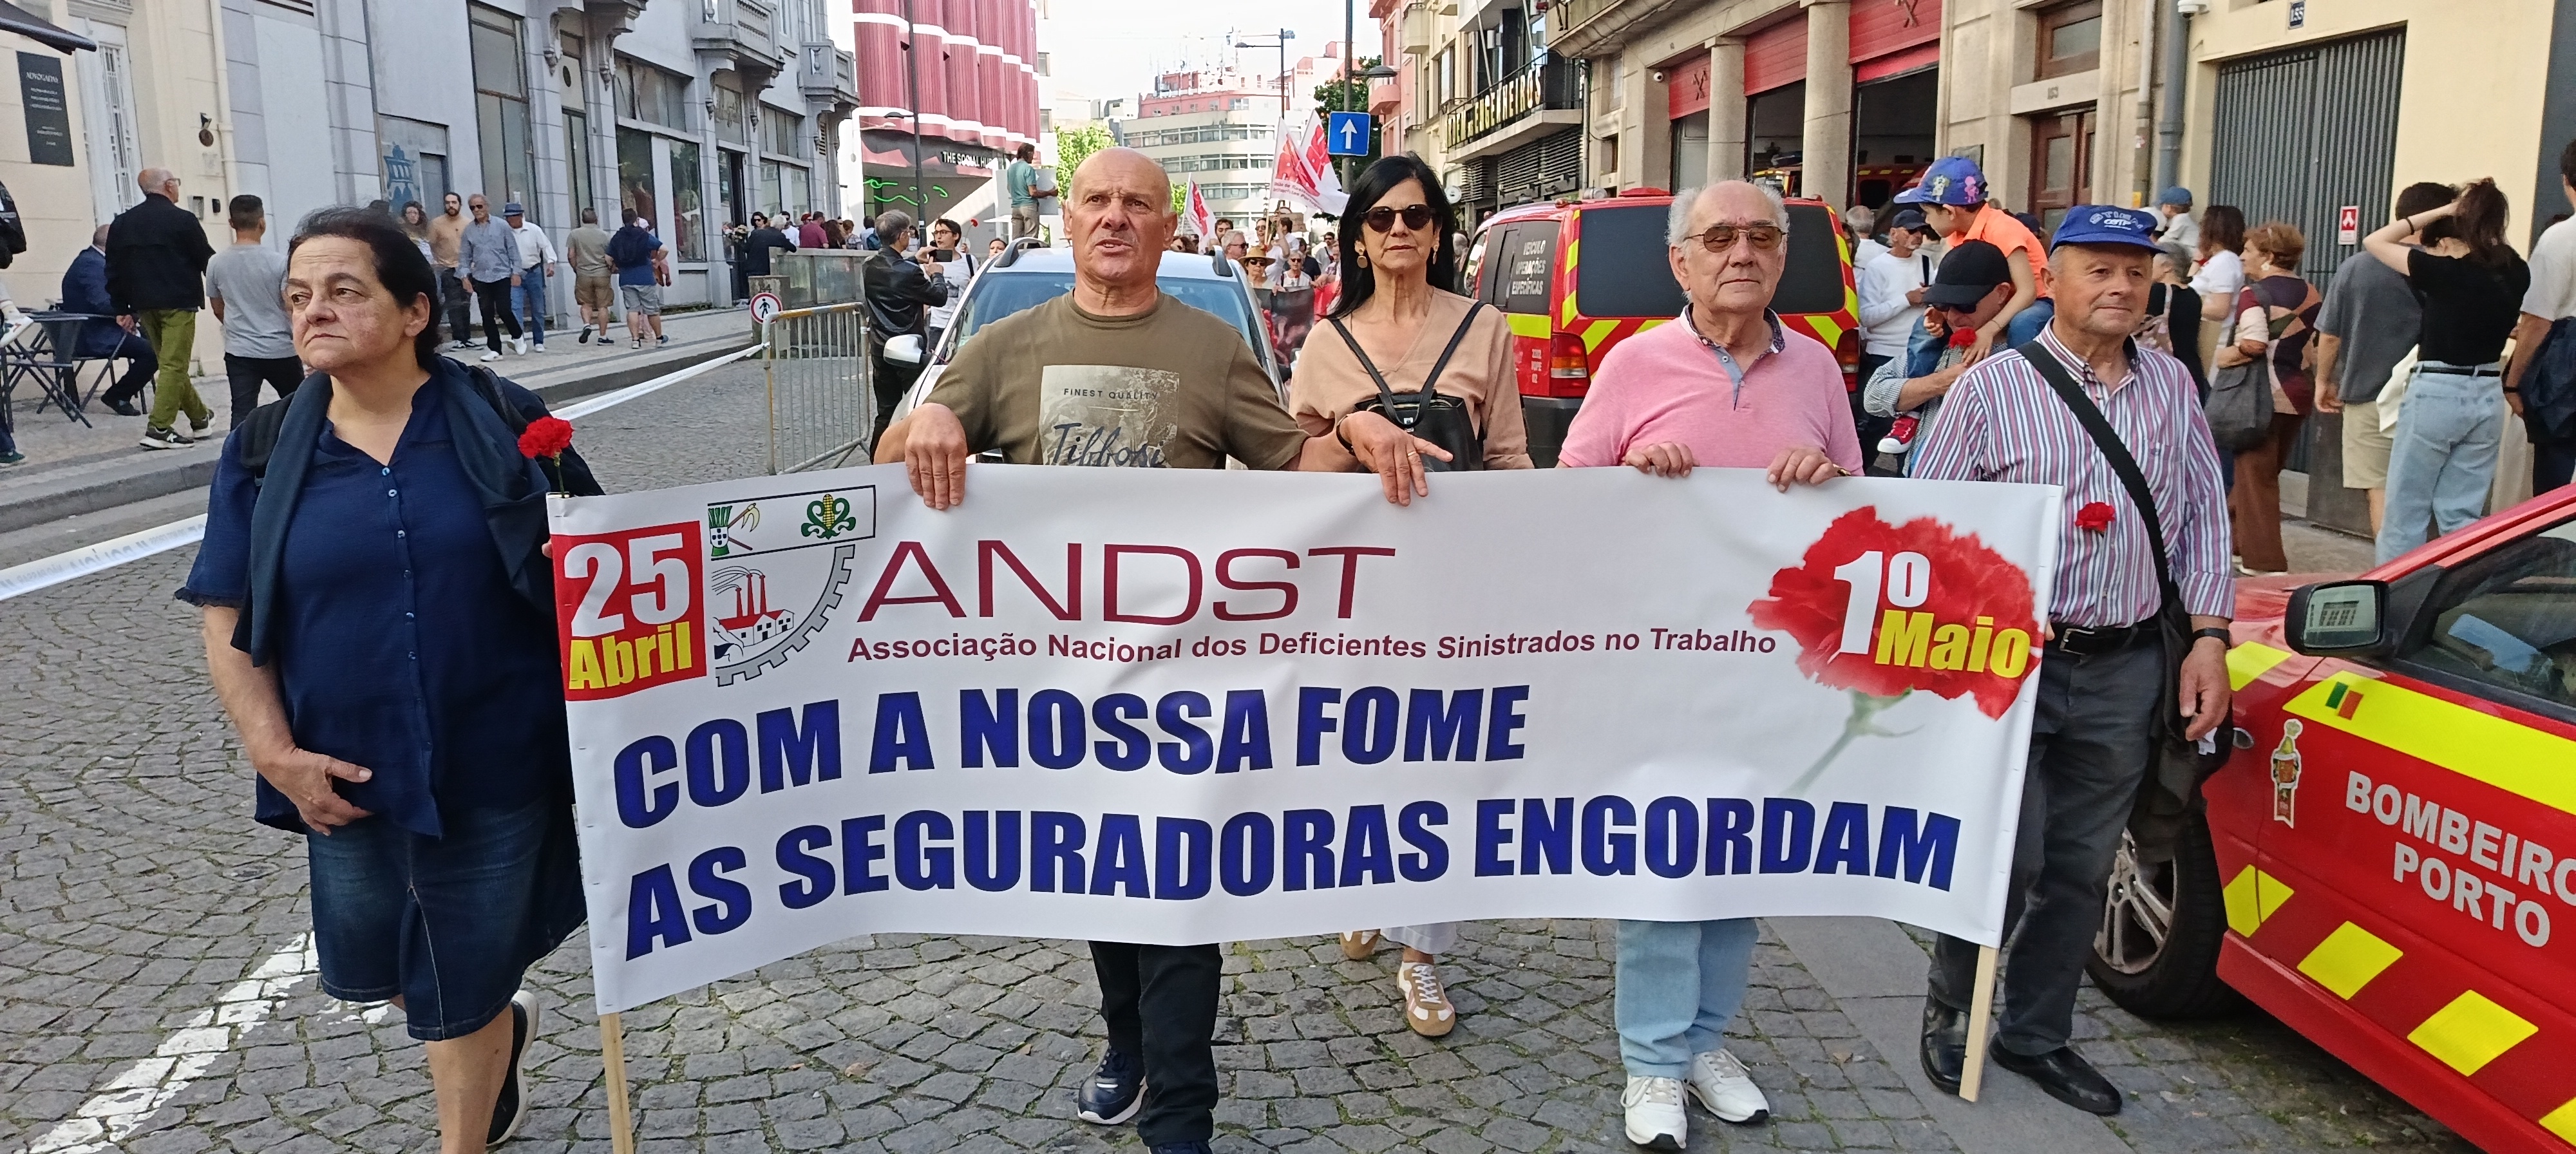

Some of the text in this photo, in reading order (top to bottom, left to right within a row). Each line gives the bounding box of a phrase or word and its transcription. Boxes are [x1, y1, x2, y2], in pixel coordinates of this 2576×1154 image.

[2291, 7, 2304, 21] 155
[1474, 66, 1541, 134] ENGENHEIROS
[942, 151, 956, 164] THE
[957, 153, 980, 167] SOCIAL
[1515, 257, 1546, 278] OPERAÇÕES
[1523, 238, 1546, 256] VEÍCULO
[1511, 278, 1544, 296] ESPECÍFICAS
[1063, 388, 1159, 400] FINEST QUALITY
[564, 532, 690, 637] 25
[857, 540, 1396, 627] ANDST
[569, 621, 692, 690] Abril
[848, 628, 1777, 663] Associação Nacional dos Deficientes Sinistrados no Trabalho
[1875, 609, 2031, 678] Maio
[614, 685, 1530, 829] COM A NOSSA FOME
[2345, 770, 2576, 907] BOMBEIRO
[625, 795, 1962, 961] AS SEGURADORAS ENGORDAM
[2393, 841, 2551, 948] PORTO
